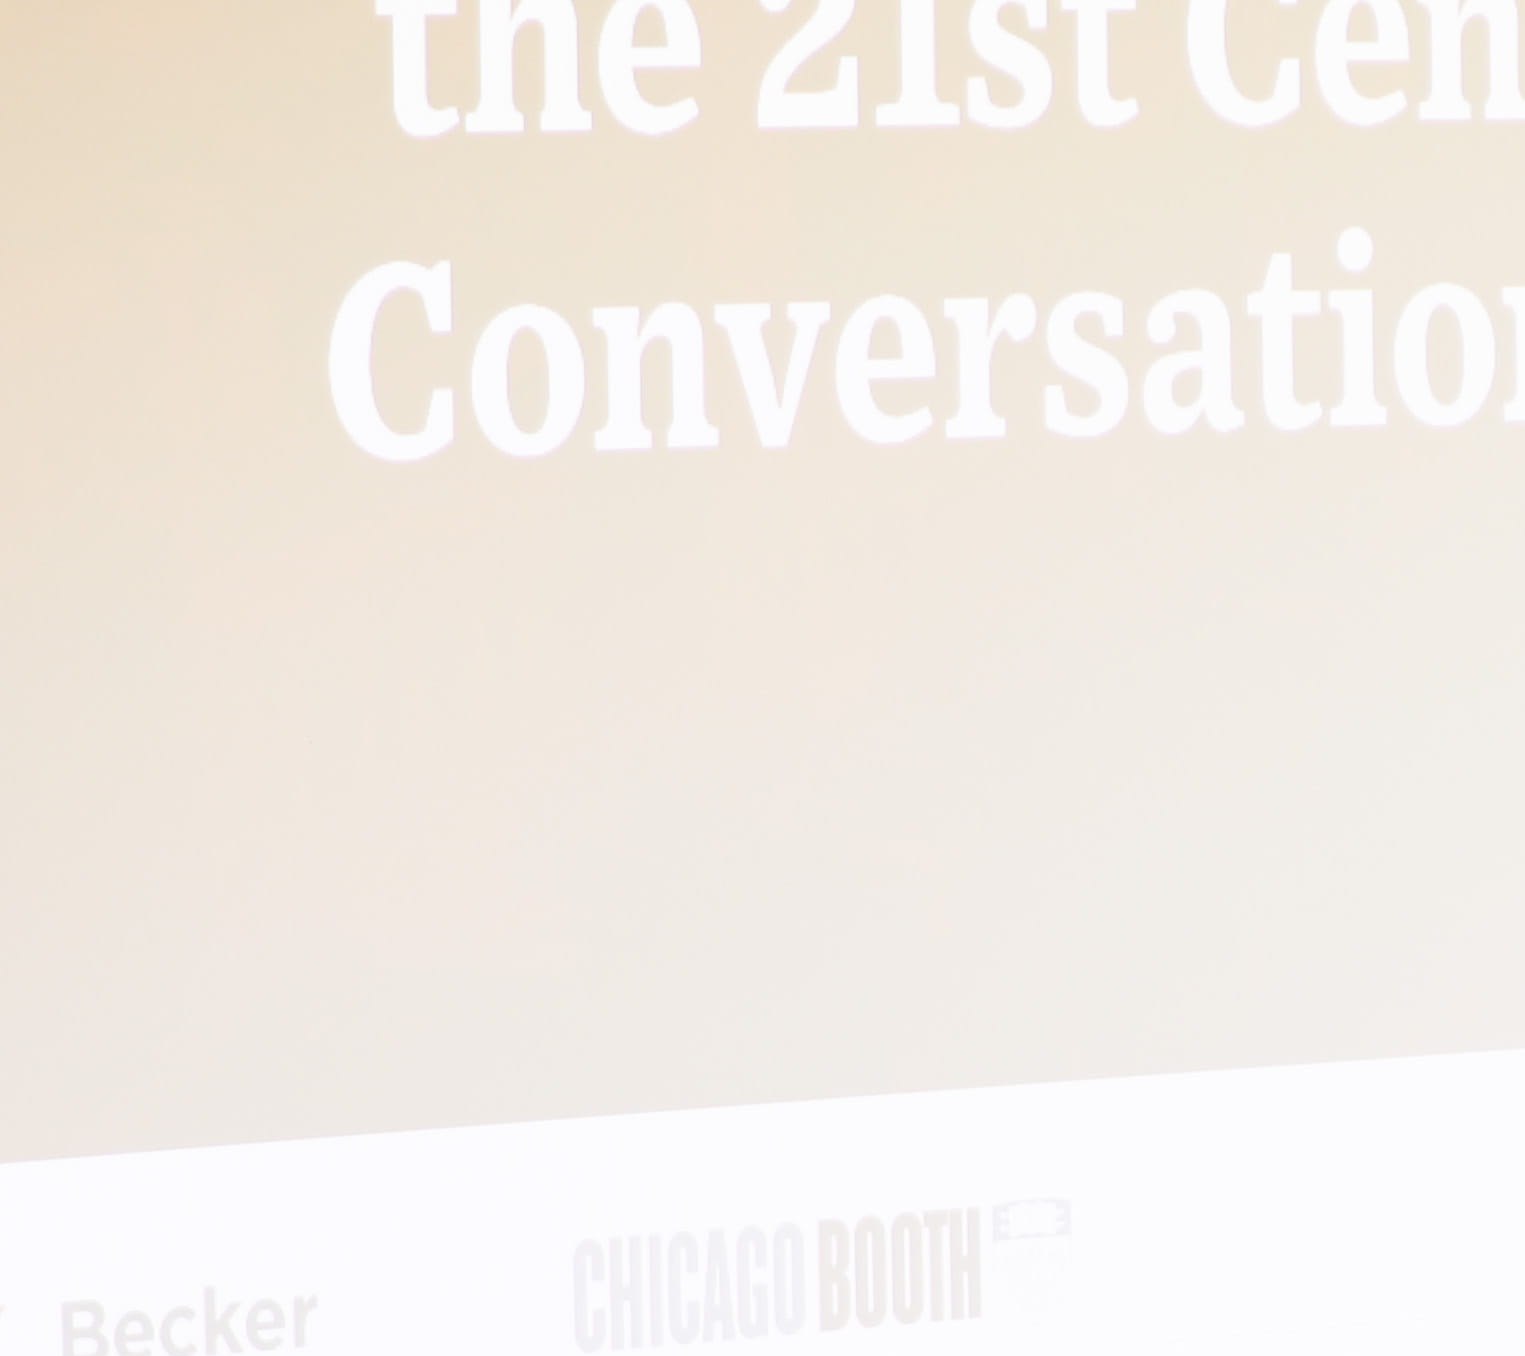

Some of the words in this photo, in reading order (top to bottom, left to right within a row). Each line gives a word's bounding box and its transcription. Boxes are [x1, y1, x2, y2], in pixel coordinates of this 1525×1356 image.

[377, 0, 701, 137] the
[758, 0, 1138, 128] 21st
[572, 1221, 806, 1355] CHICAGO
[817, 1206, 983, 1334] BOOTH
